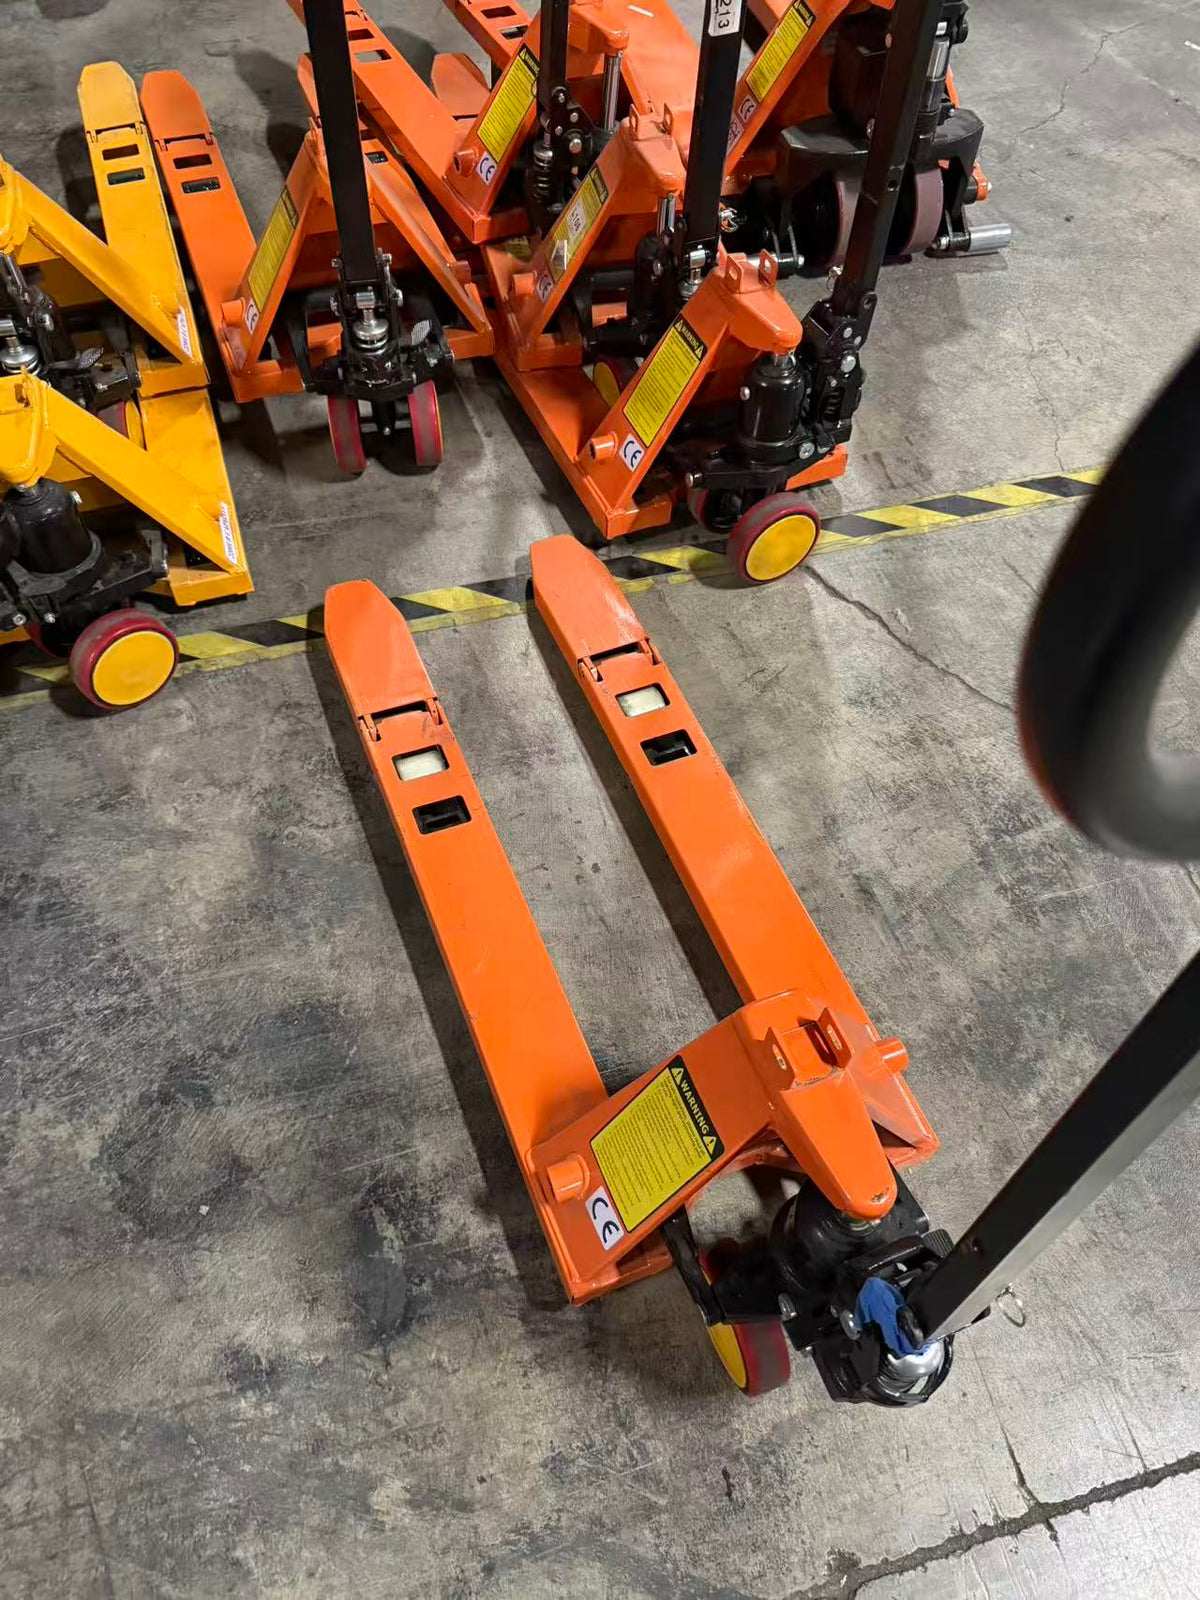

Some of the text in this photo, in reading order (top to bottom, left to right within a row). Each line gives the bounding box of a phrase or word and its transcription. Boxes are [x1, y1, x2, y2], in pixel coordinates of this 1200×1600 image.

[480, 157, 495, 182] CE
[624, 440, 642, 468] CE
[680, 1079, 710, 1135] WARNING
[592, 1197, 620, 1244] CE
